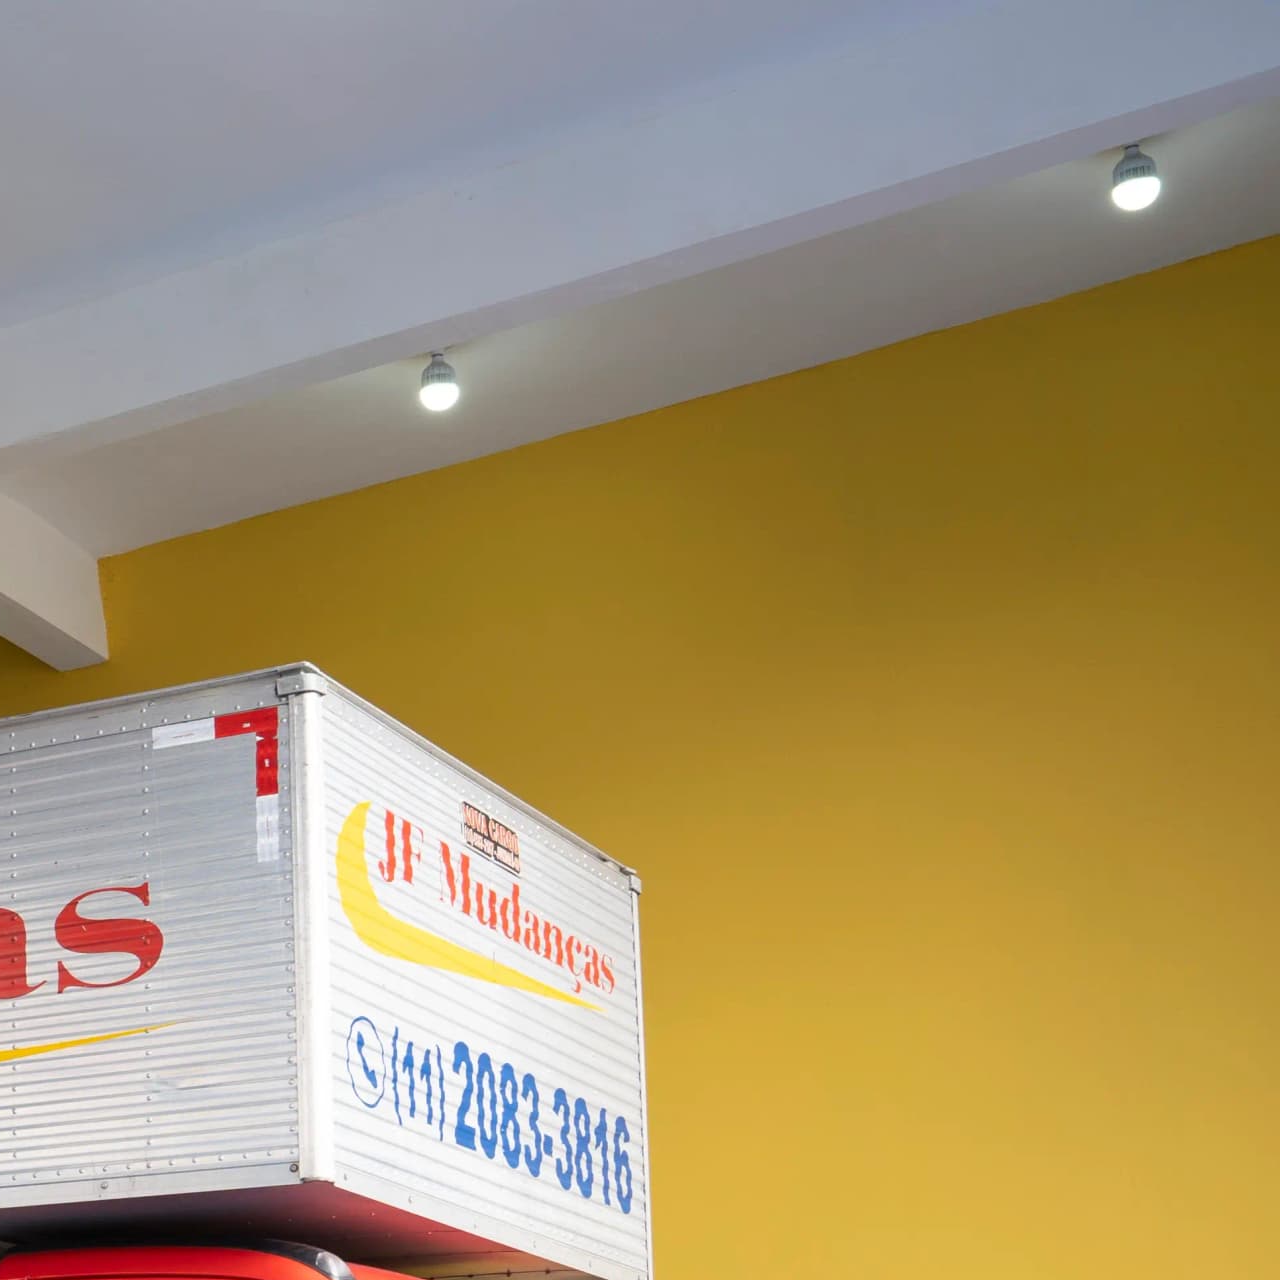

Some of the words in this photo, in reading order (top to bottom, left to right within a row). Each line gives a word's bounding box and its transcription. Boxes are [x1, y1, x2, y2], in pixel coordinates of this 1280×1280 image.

[439, 841, 617, 996] Mudanças
[392, 1027, 445, 1142] (11)
[453, 1041, 633, 1215] 2083-3816
